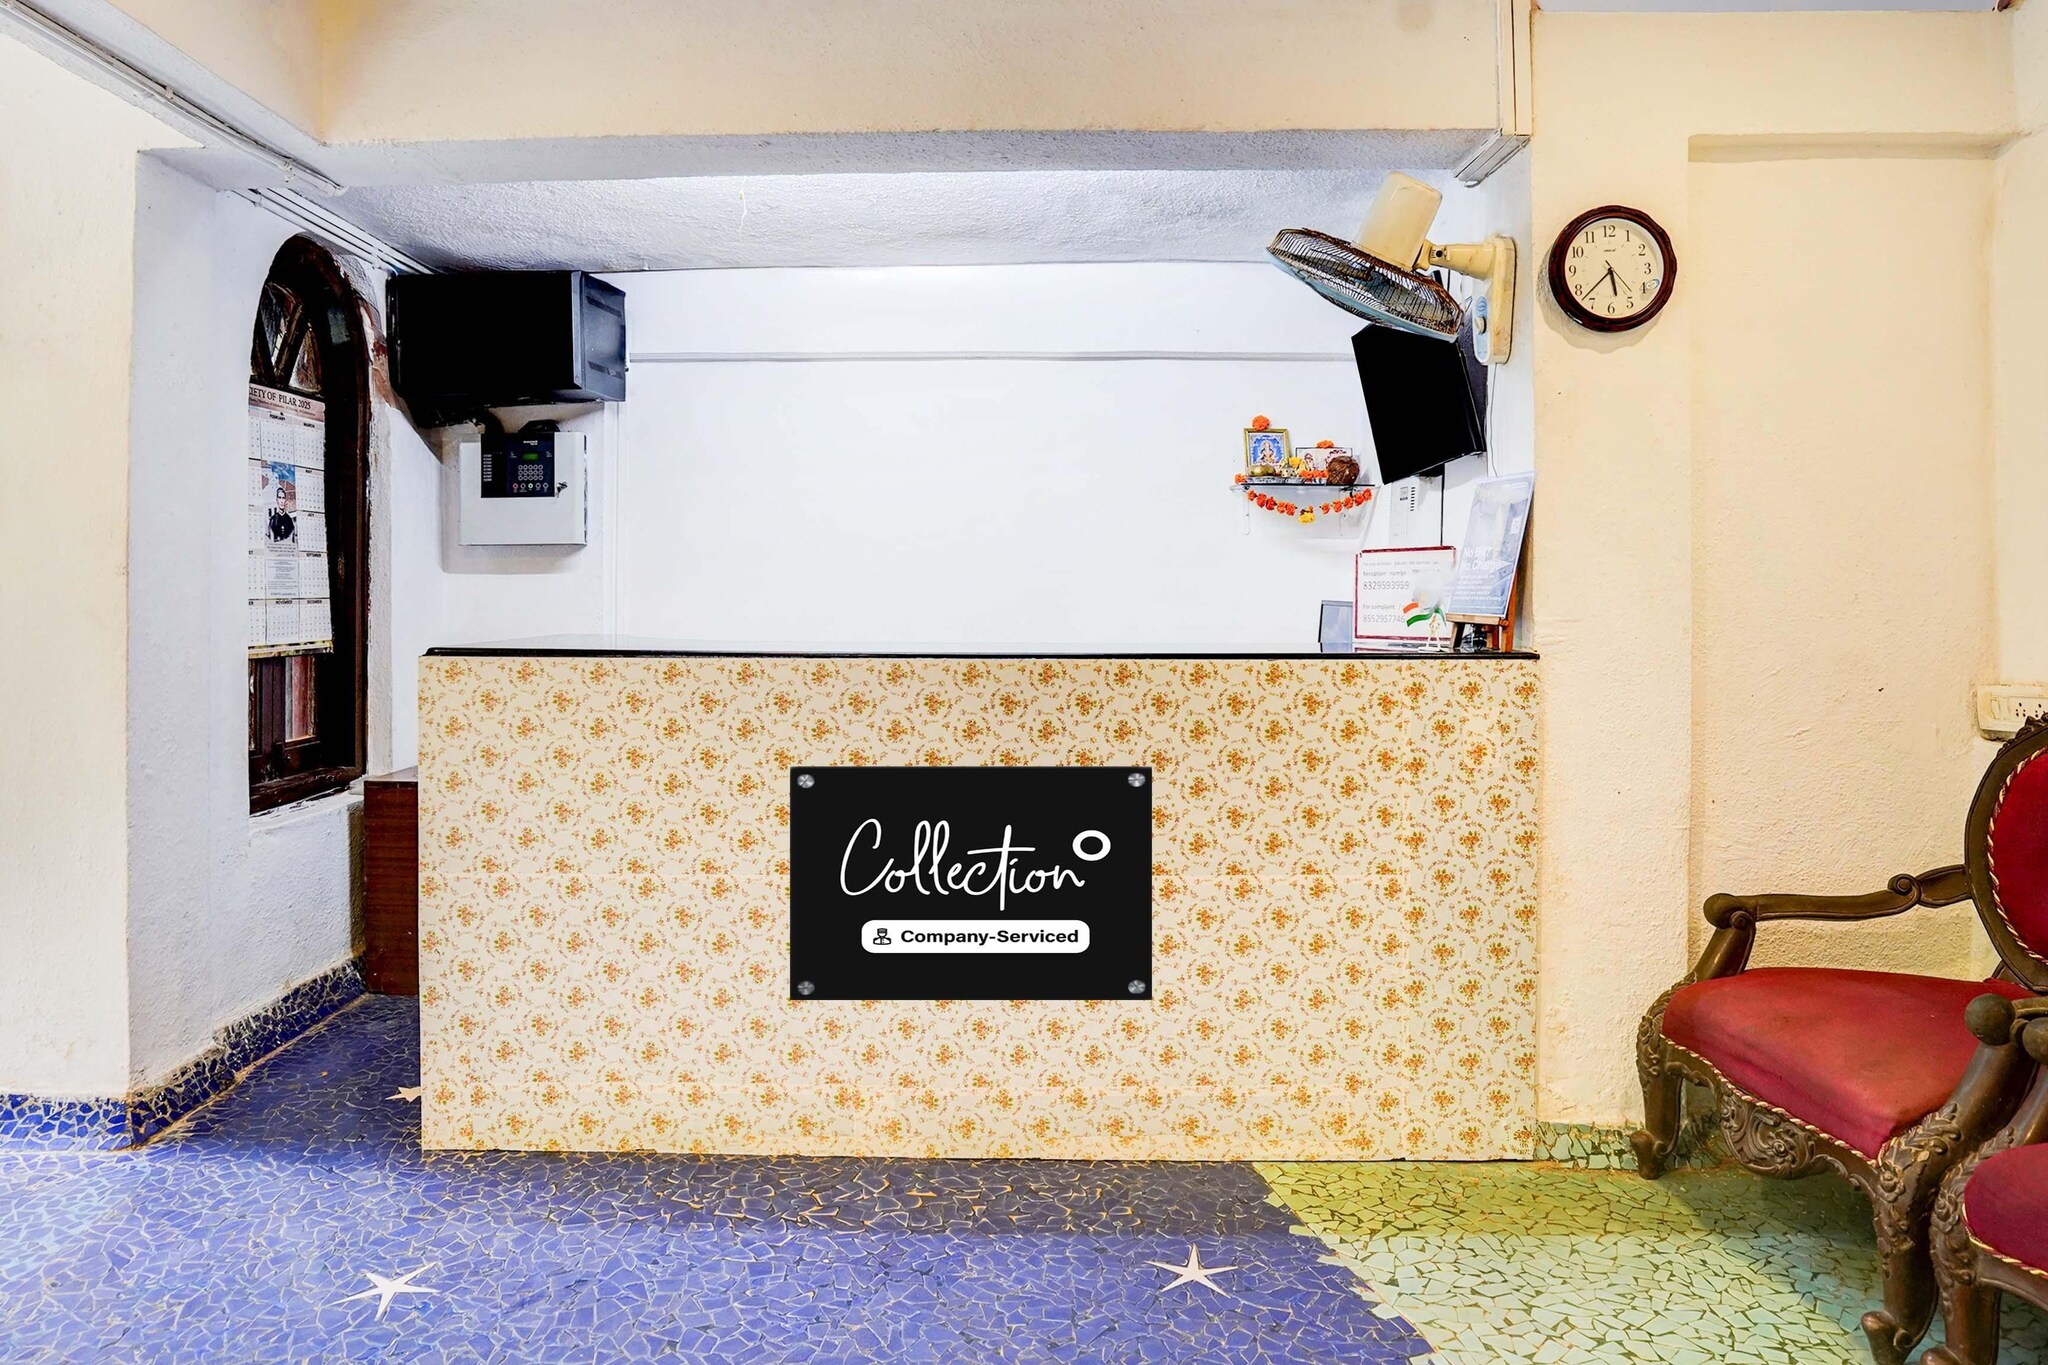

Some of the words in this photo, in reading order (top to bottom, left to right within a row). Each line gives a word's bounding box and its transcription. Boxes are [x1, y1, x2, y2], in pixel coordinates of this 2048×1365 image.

[1585, 231, 1595, 243] 11
[1602, 225, 1616, 238] 12
[1625, 230, 1630, 242] 1
[1572, 246, 1584, 258] 10
[1638, 244, 1646, 256] 2
[1568, 265, 1576, 277] 9
[1644, 262, 1651, 274] 3
[1575, 284, 1583, 296] 8
[1640, 282, 1647, 294] 4
[1588, 297, 1595, 309] 7
[1607, 302, 1615, 314] 6
[1626, 296, 1634, 309] 5
[267, 391, 276, 400] OF
[278, 394, 297, 407] PILAR
[298, 399, 311, 410] 2025
[1463, 547, 1474, 557] No
[1460, 560, 1471, 570] No
[840, 818, 1086, 911] Collection
[900, 929, 1079, 946] Company-Serviced
